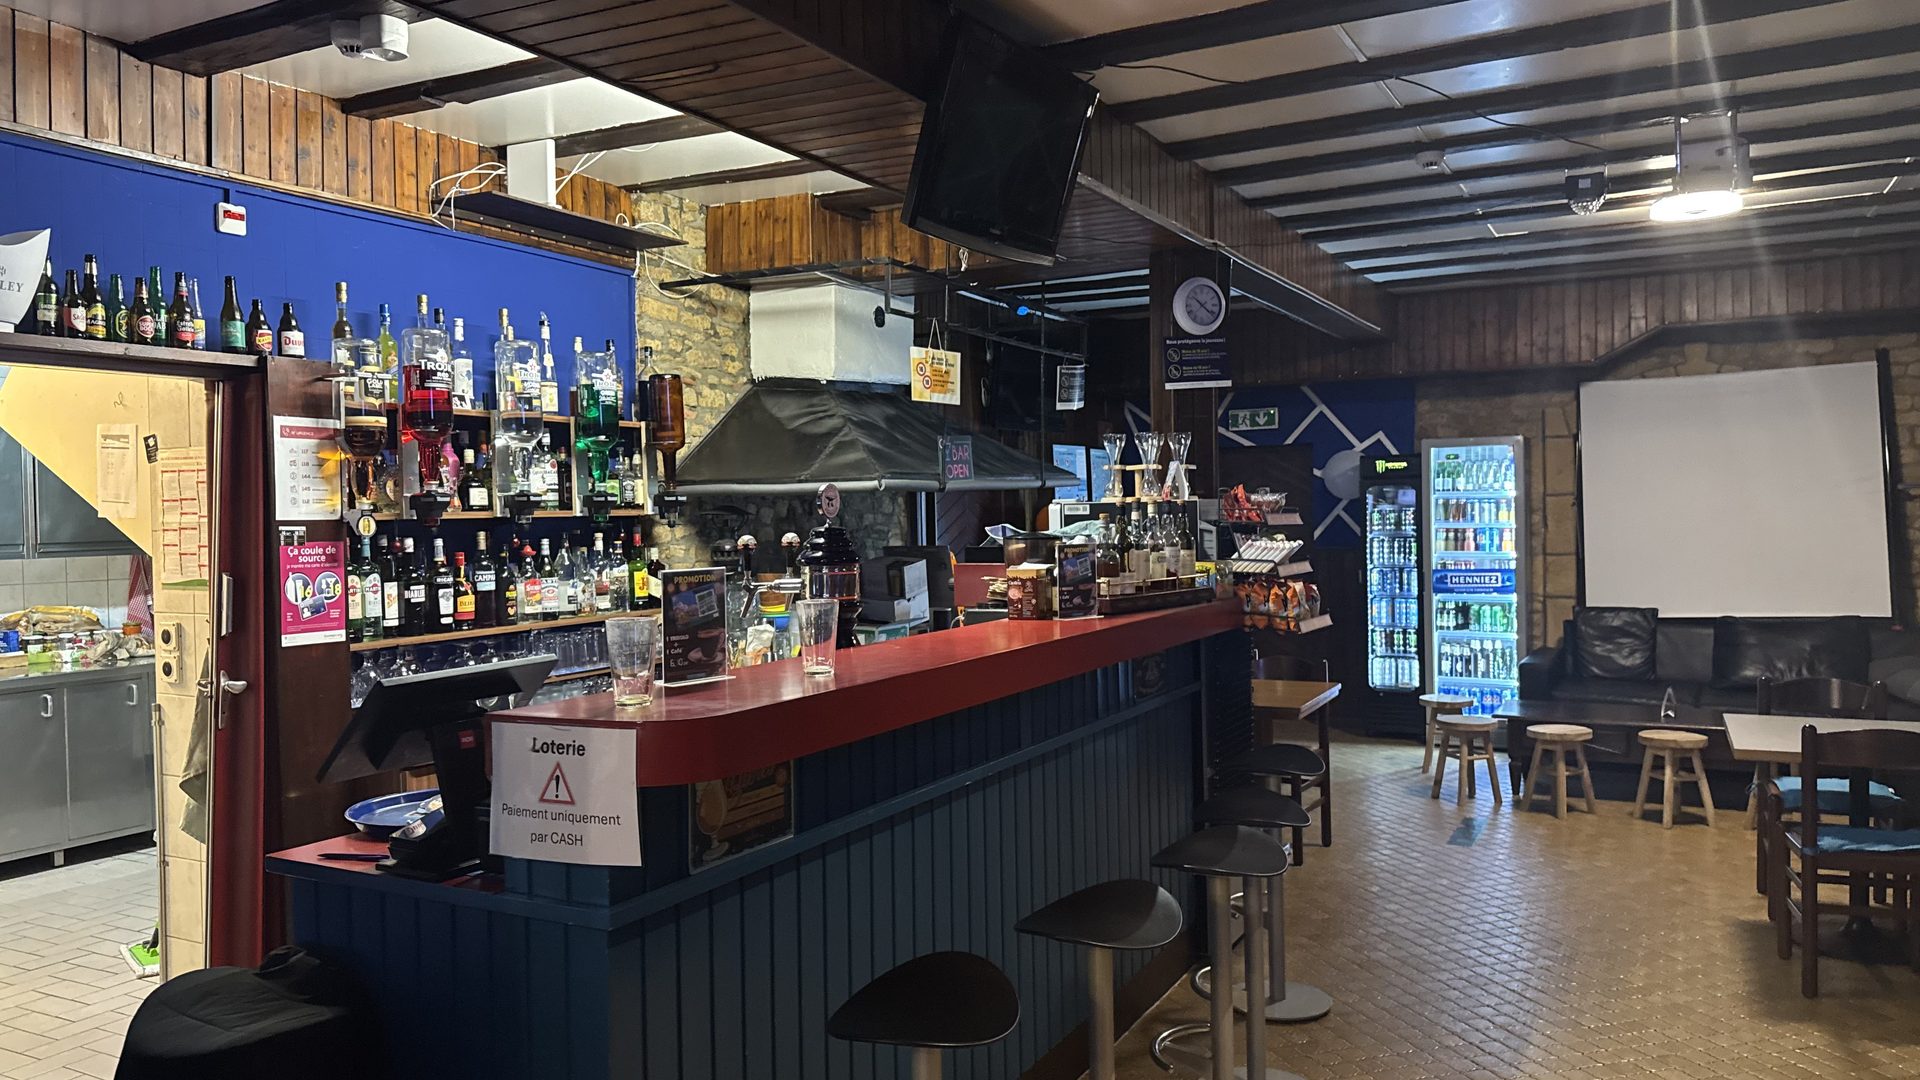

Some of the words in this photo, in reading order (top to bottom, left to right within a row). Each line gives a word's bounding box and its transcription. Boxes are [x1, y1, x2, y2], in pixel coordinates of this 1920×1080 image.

[951, 444, 970, 461] BAR
[946, 463, 969, 478] OPEN
[287, 546, 299, 557] Ça
[300, 546, 324, 555] coule
[325, 545, 337, 554] de
[298, 554, 326, 562] source
[674, 575, 716, 584] PROMOTION
[1452, 576, 1498, 584] HENNIEZ
[531, 737, 586, 756] Loterie
[501, 803, 548, 820] Paiement
[550, 810, 621, 826] uniquement
[530, 832, 547, 844] par
[551, 832, 584, 846] CASH
